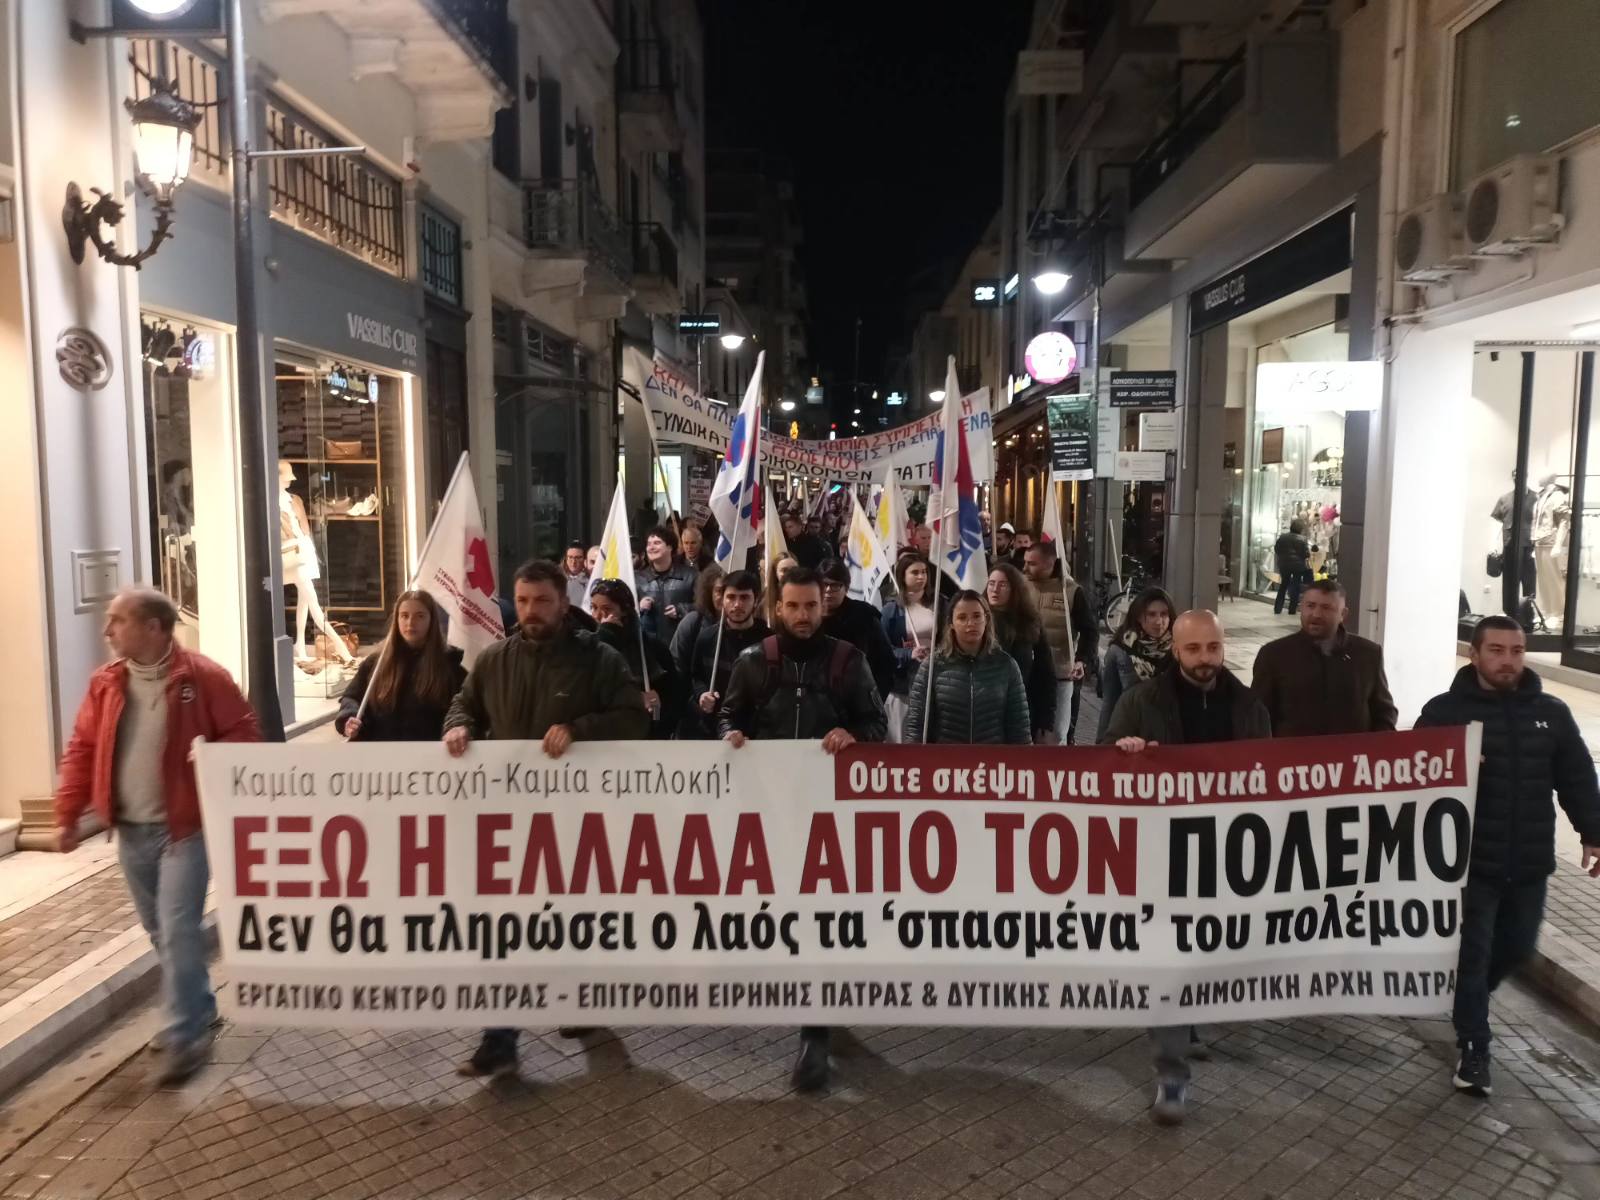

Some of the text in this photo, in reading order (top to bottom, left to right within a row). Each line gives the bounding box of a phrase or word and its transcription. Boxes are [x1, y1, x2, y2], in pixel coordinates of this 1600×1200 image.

[347, 312, 417, 356] VASSILIS CUIR
[683, 395, 702, 412] ΘΑ
[888, 440, 905, 454] ΤΑ
[231, 764, 317, 802] Καμία
[601, 762, 732, 799] εμπλοκή!
[850, 748, 1455, 803] Ούτε σκέψη για πυρηνικά στον Άραξο!
[233, 797, 1471, 898] ΕΞΩ Η ΕΛΛΑΔΑ ΑΠΟ ΤΟΝ ΠΟΛΕΜΟ
[238, 903, 314, 953] Δεν
[330, 903, 387, 954] θα
[404, 901, 636, 959] πληρώσει
[652, 910, 677, 951] ο
[693, 900, 799, 955] λαός
[814, 911, 867, 950] τα
[1171, 913, 1250, 952] του
[238, 982, 342, 1011] ΕΡΓΑΤΙΚΟ
[352, 983, 446, 1012] ΚΕΝΤΡΟ
[456, 982, 549, 1011] ΠΑΤΡΑΣ
[578, 982, 699, 1009] ΕΠΙΤΡΟΠΗ
[708, 981, 812, 1008] ΕΙΡΗΝΗΣ
[822, 981, 913, 1008] ΠΑΤΡΑΣ
[922, 981, 938, 1007] &
[948, 980, 1050, 1008] ΔΥΤΙΚΗΣ
[1060, 978, 1150, 1010] ΑΧΑΪΑΣ
[1179, 973, 1300, 1008] ΔΗΜΟΤΙΚΗ
[1309, 970, 1373, 998] ΑΡΧΗ
